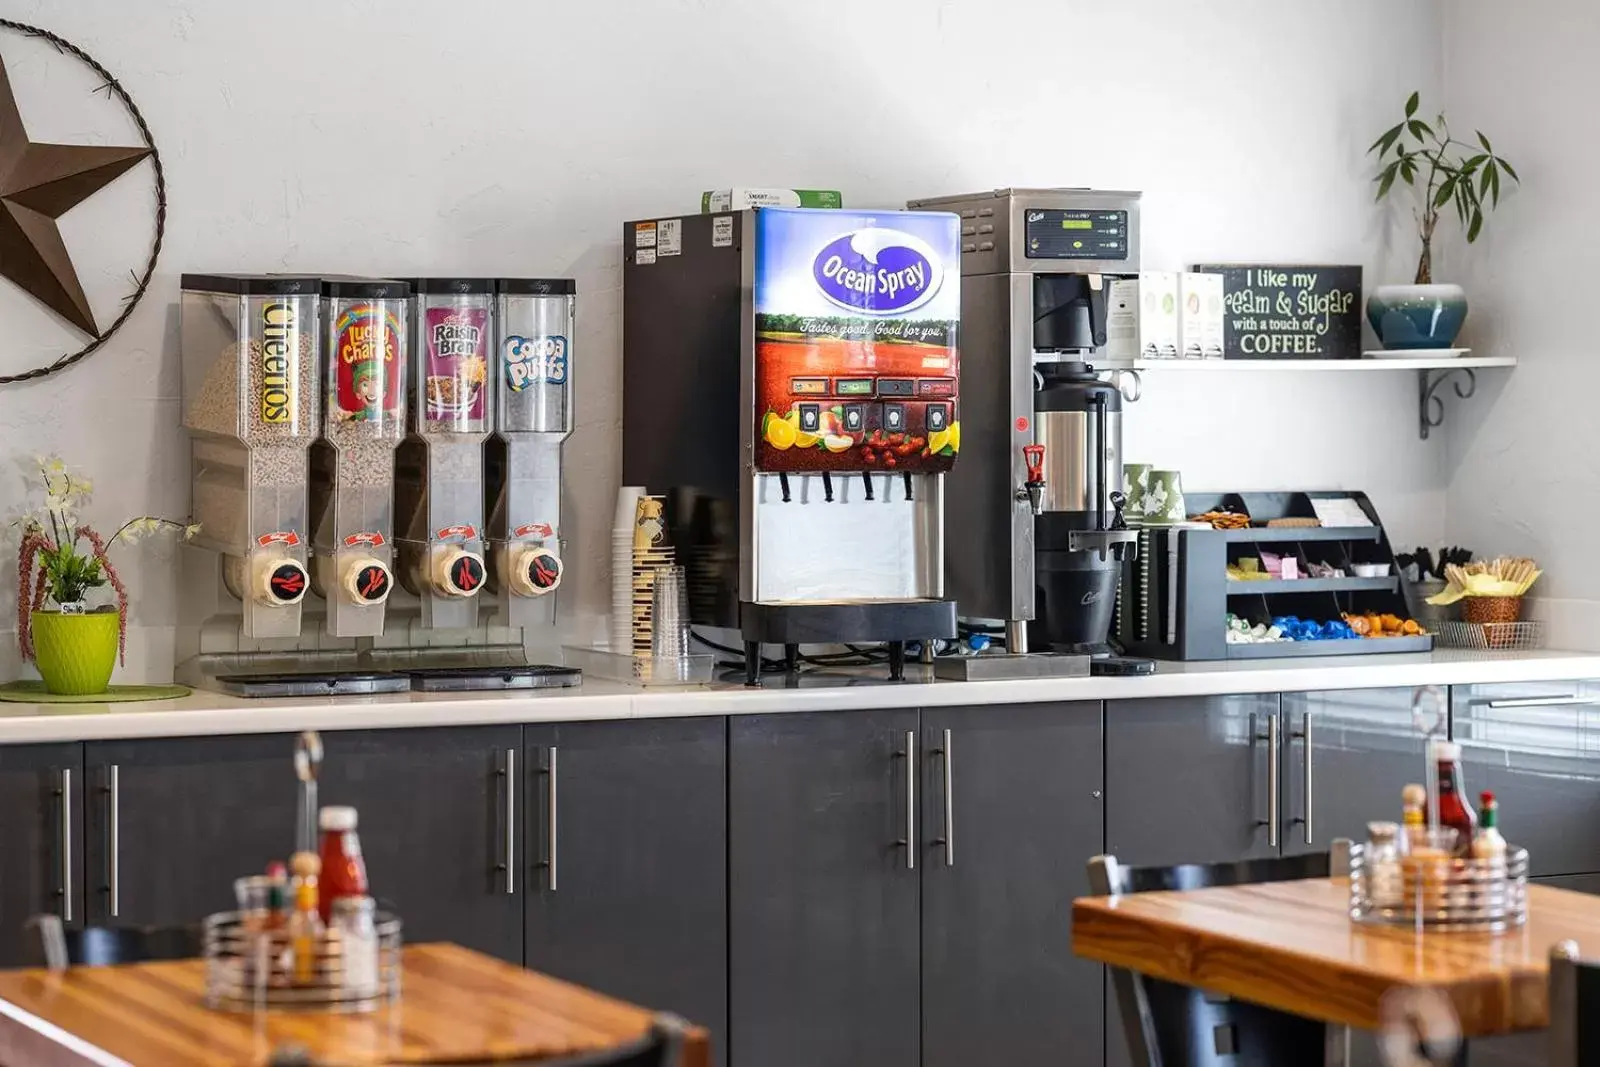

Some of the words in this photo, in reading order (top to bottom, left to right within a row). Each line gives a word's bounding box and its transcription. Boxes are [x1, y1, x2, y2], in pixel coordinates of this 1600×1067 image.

[823, 255, 876, 293] Ocean
[877, 260, 925, 299] Spray
[1247, 270, 1252, 287] I
[1258, 269, 1288, 287] like
[1292, 274, 1318, 291] my
[1223, 289, 1270, 314] ream
[1275, 291, 1293, 316] &
[1297, 289, 1354, 335] Sugar
[435, 325, 479, 341] Raisin
[800, 319, 836, 333] Tastes
[875, 321, 901, 335] Good
[903, 323, 920, 338] for
[1232, 318, 1257, 330] with
[1260, 320, 1267, 330] a
[1270, 318, 1299, 330] touch
[1302, 317, 1316, 330] of
[440, 340, 474, 355] Bran
[1240, 334, 1322, 353] COFFEE.
[264, 303, 293, 420] Cheerios
[509, 358, 564, 387] Pufs
